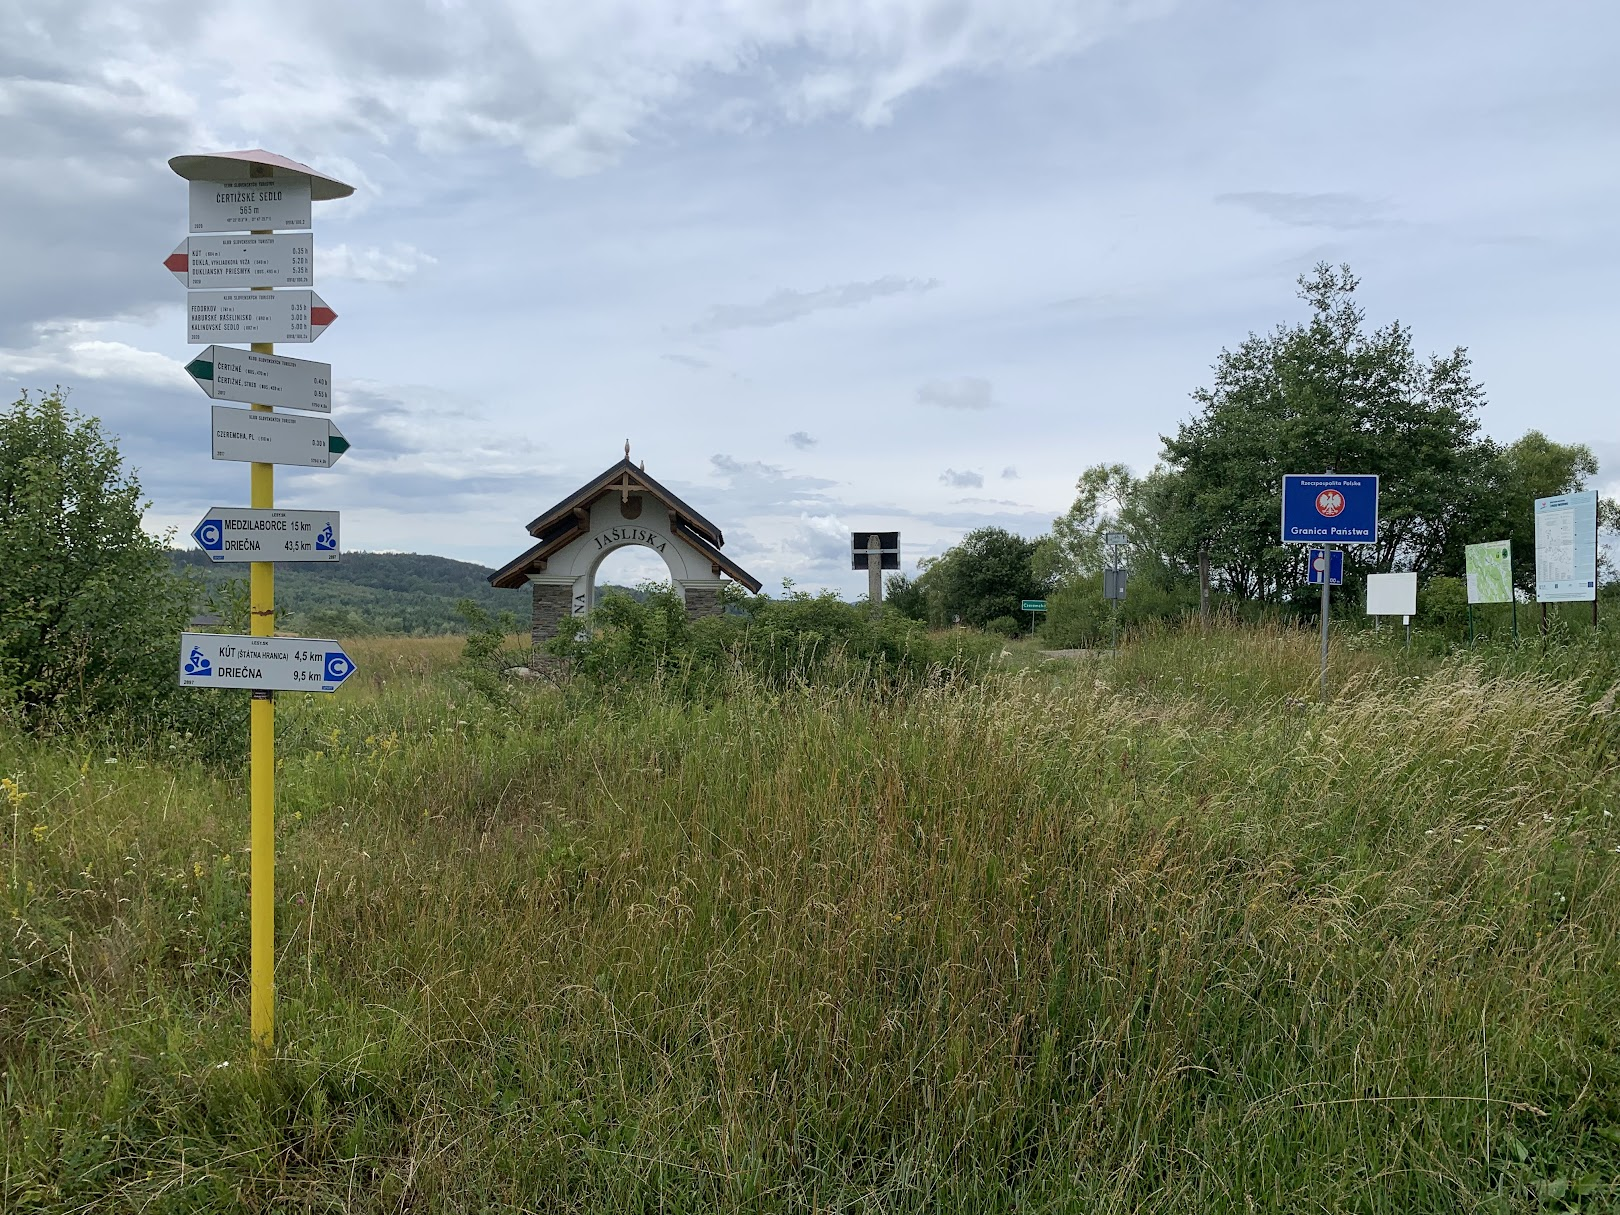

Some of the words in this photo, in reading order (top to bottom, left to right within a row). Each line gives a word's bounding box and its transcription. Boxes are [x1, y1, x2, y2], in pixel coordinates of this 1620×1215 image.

[216, 192, 255, 203] ČERTIŽSKÉ
[260, 191, 282, 201] SEDLO
[240, 206, 252, 215] 565
[218, 362, 242, 373] ČERTIŽNÉ
[216, 430, 247, 440] CZEREMCHA,
[224, 520, 287, 531] MEDZILABORCE
[290, 521, 299, 531] 15
[300, 522, 312, 531] km
[1291, 527, 1327, 535] Granica
[1331, 527, 1369, 535] Państwa
[225, 538, 261, 551] DRIEČNA
[284, 541, 299, 552] 43,5
[300, 541, 312, 550] km
[219, 645, 236, 658] KÚT
[238, 650, 261, 660] (ŠTÁTNA
[262, 652, 288, 661] HRANICA)
[295, 650, 307, 662] 4,5
[309, 651, 323, 661] km
[218, 666, 262, 679] DRIEČNA
[293, 671, 306, 682] 9,5
[308, 671, 321, 681] km
